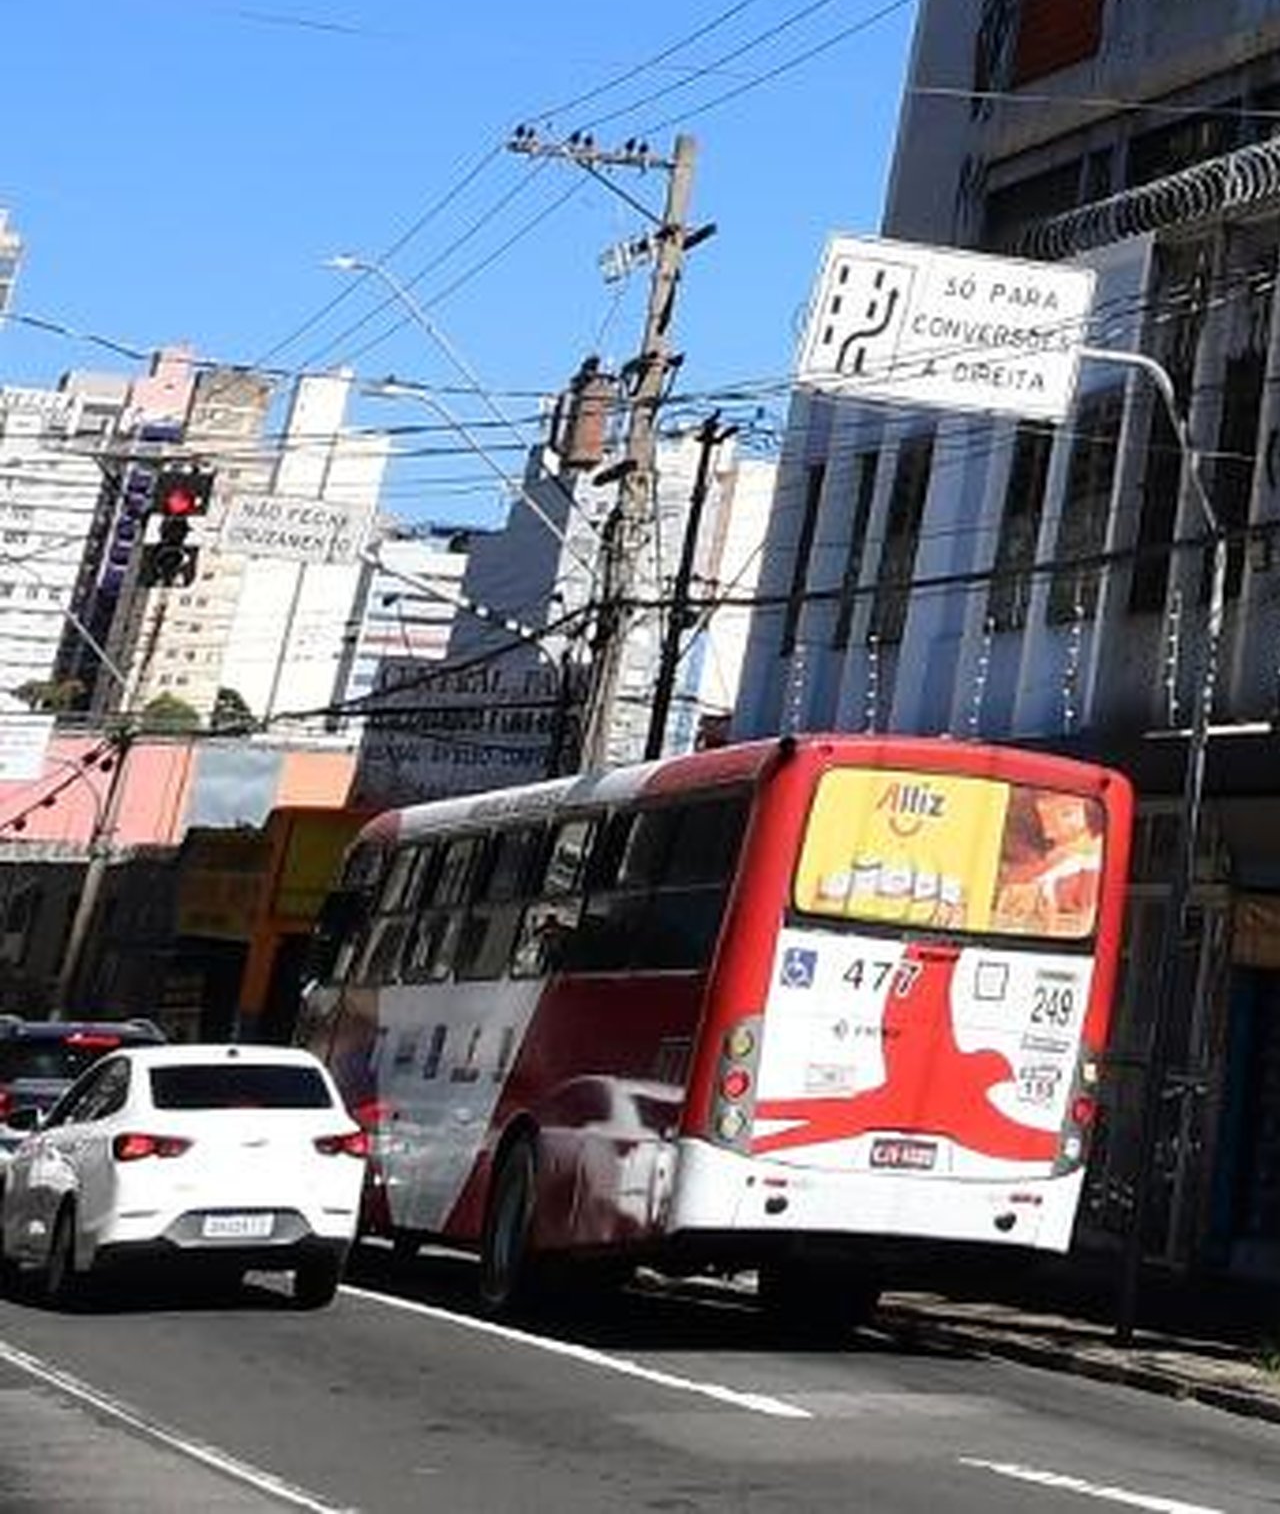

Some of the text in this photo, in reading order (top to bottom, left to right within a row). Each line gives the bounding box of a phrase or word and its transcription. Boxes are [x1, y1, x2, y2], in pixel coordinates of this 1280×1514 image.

[943, 272, 1059, 310] SÓ PARA
[952, 361, 1045, 391] DIREITA
[1030, 986, 1074, 1027] 249
